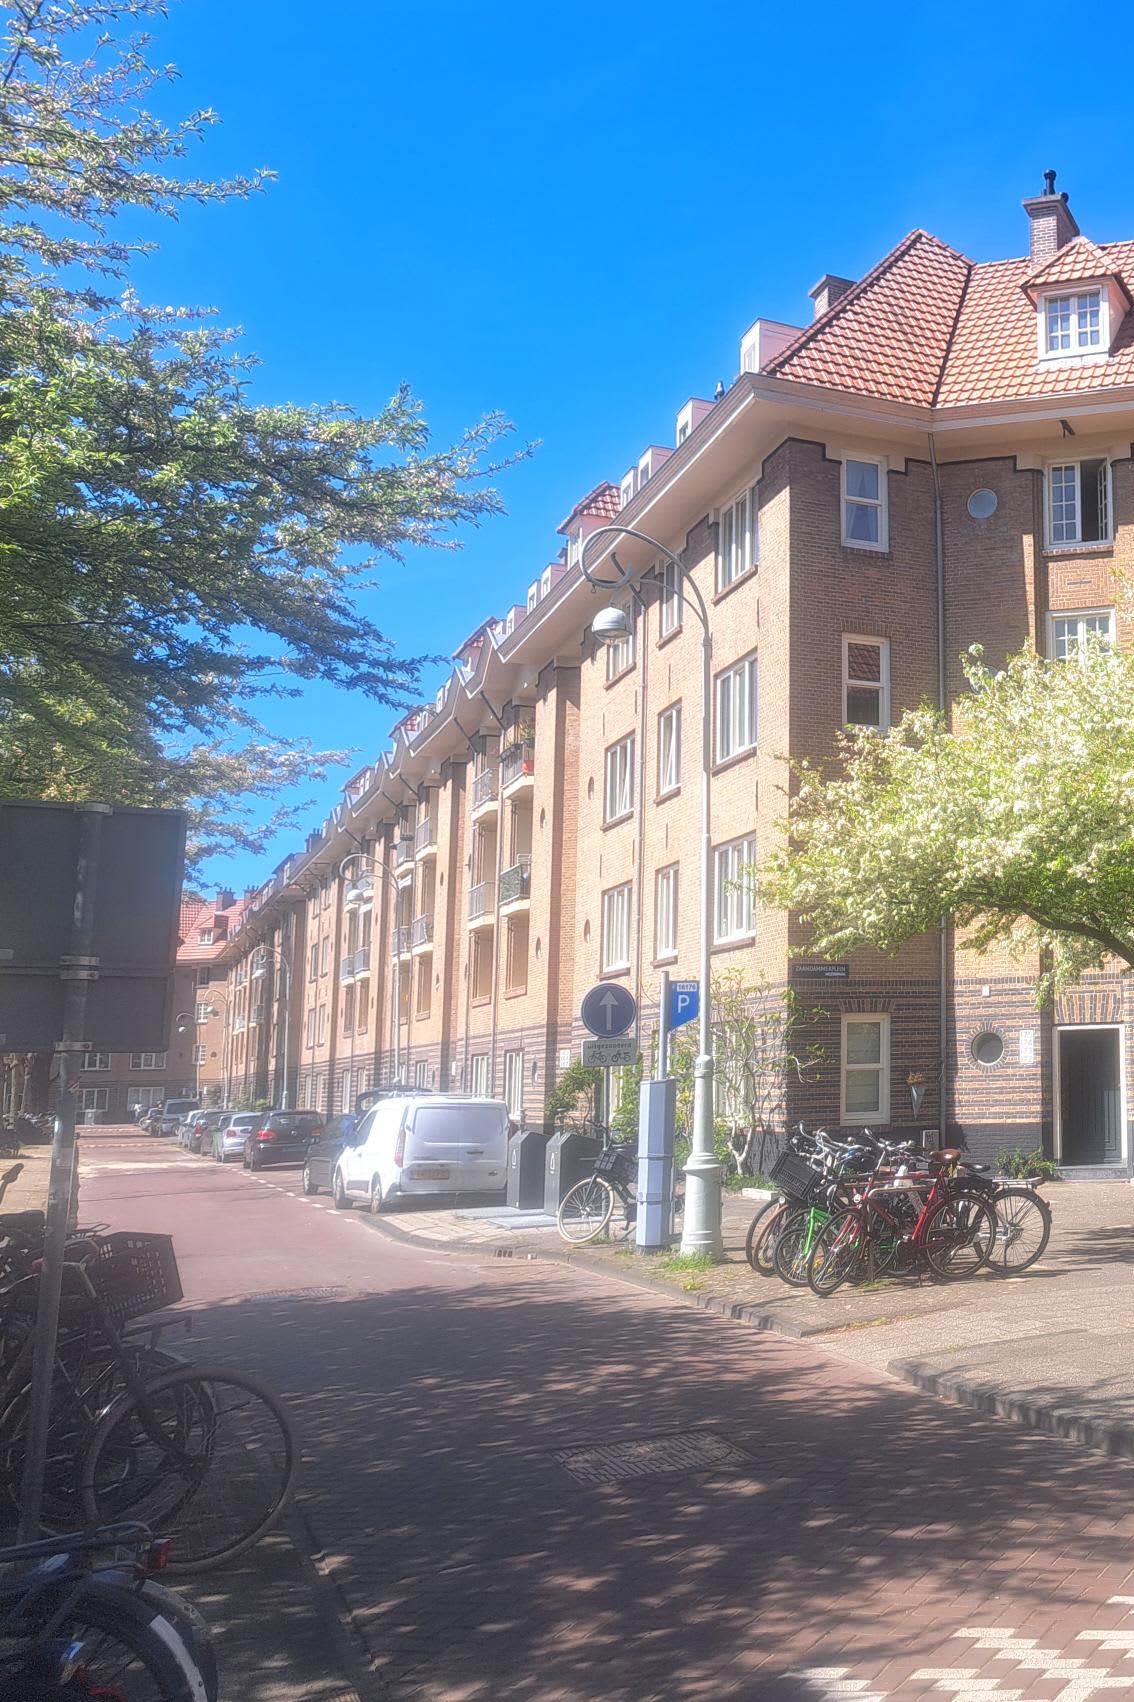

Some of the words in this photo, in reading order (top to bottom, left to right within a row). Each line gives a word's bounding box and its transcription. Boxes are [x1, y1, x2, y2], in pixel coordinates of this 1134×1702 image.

[795, 964, 846, 972] ZAANDAMMERPLEIN
[678, 994, 690, 1013] P
[587, 1042, 633, 1050] uitgezonderd
